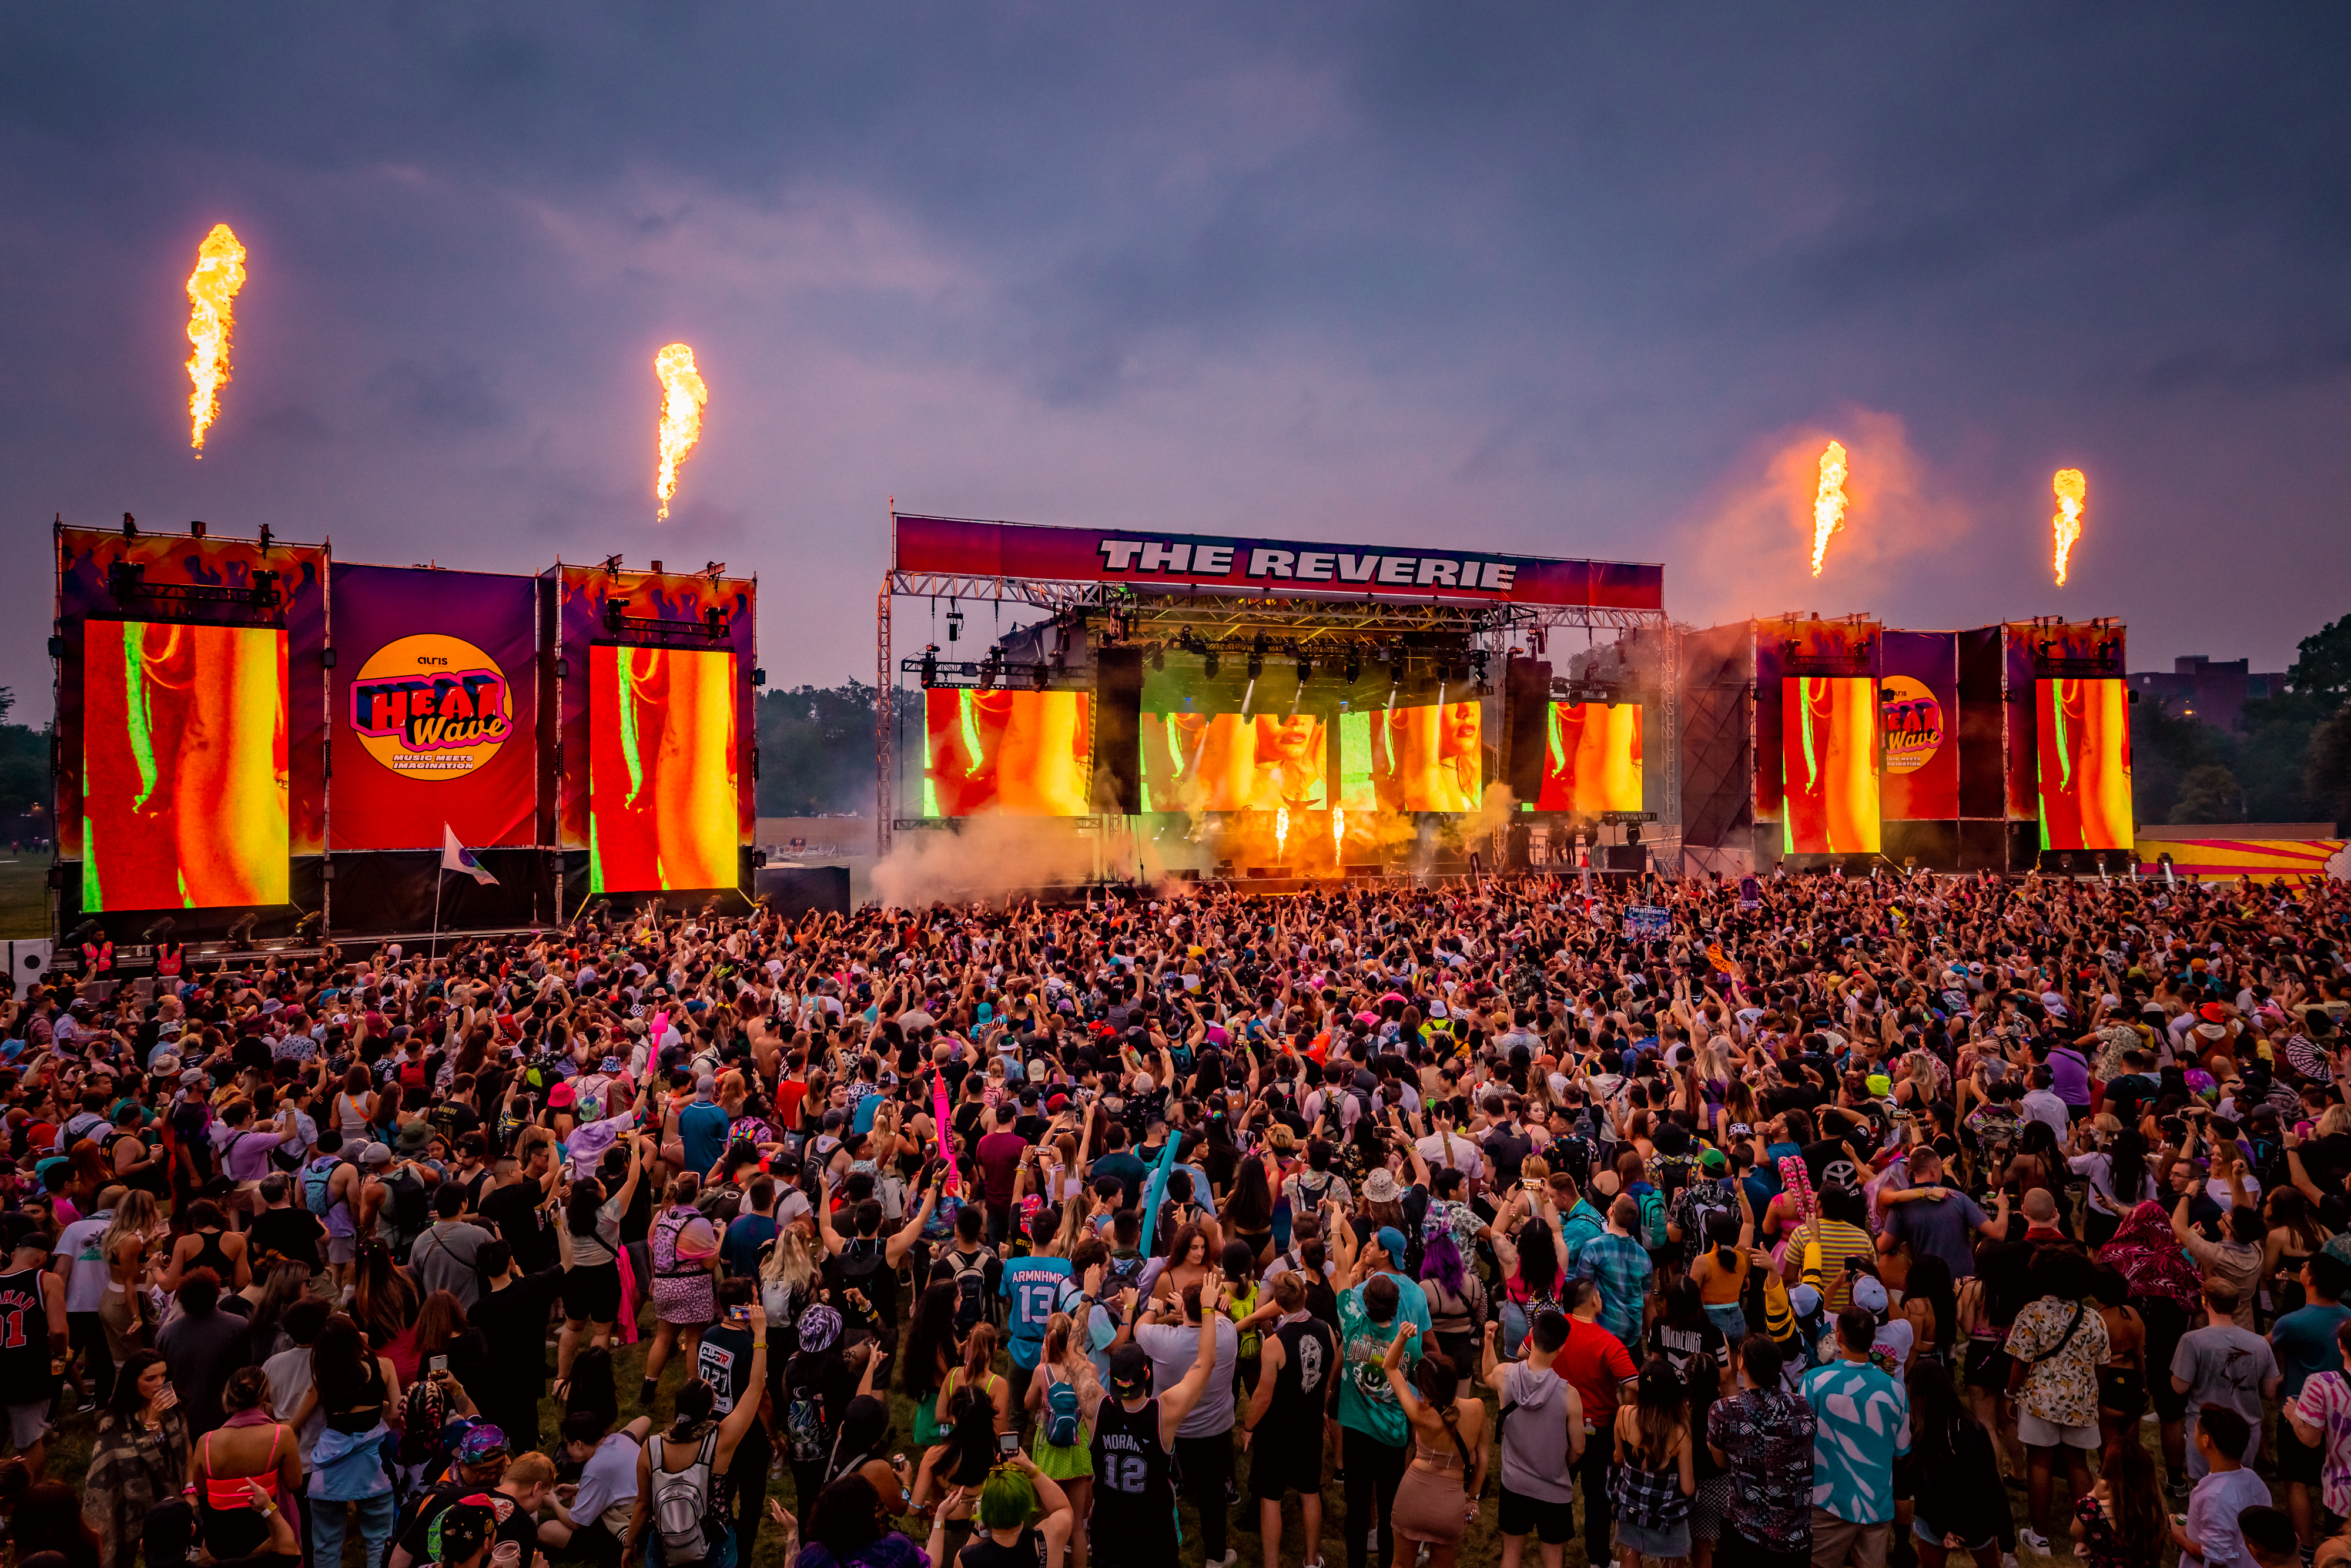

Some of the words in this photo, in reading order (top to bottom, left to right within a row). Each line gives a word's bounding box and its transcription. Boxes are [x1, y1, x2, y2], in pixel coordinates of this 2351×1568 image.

[1100, 540, 1235, 574] THE
[1249, 547, 1518, 590] REVERIE
[368, 680, 499, 731] HEAT
[413, 716, 507, 746] Wave
[1888, 731, 1940, 751] Wave
[1629, 906, 1671, 915] HeatBaes?
[946, 1120, 954, 1152] CRAYON
[1013, 1269, 1064, 1284] ARMNHMR
[0, 1289, 36, 1312] MAN
[1019, 1285, 1055, 1324] 13
[1661, 1325, 1702, 1353] BORGEOUS
[1103, 1434, 1146, 1453] MORAN
[1104, 1452, 1147, 1494] 12
